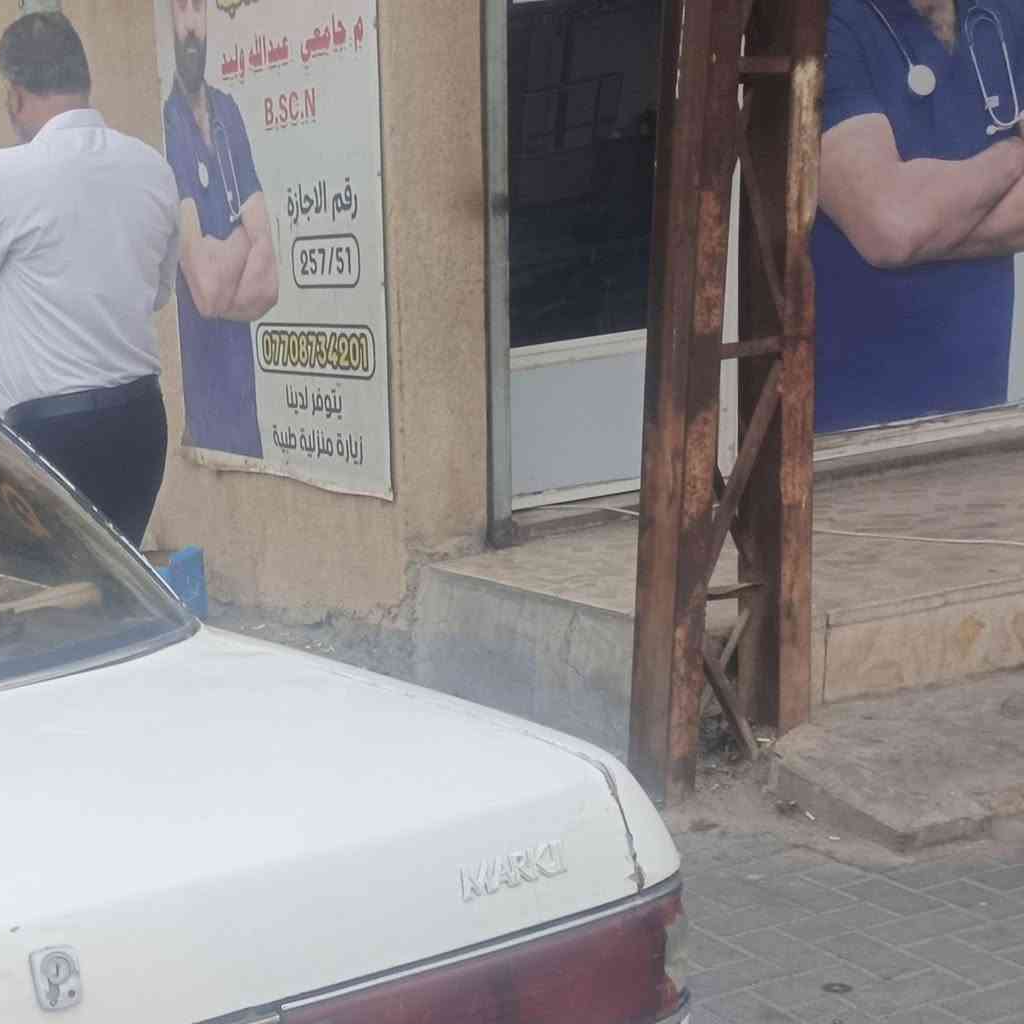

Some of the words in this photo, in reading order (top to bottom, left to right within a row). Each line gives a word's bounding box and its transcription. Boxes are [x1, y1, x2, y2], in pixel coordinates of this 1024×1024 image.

[248, 32, 288, 68] عبدالله
[263, 87, 317, 127] B.SC.N
[287, 179, 327, 225] الاجازة
[332, 176, 358, 223] رقم
[299, 246, 352, 277] 257/51
[261, 329, 370, 373] 07708734201
[285, 383, 309, 414] لدينا
[311, 387, 343, 420] يتوفر
[272, 424, 297, 454] طبية
[299, 427, 334, 459] منزلية
[336, 432, 364, 465] زيارة
